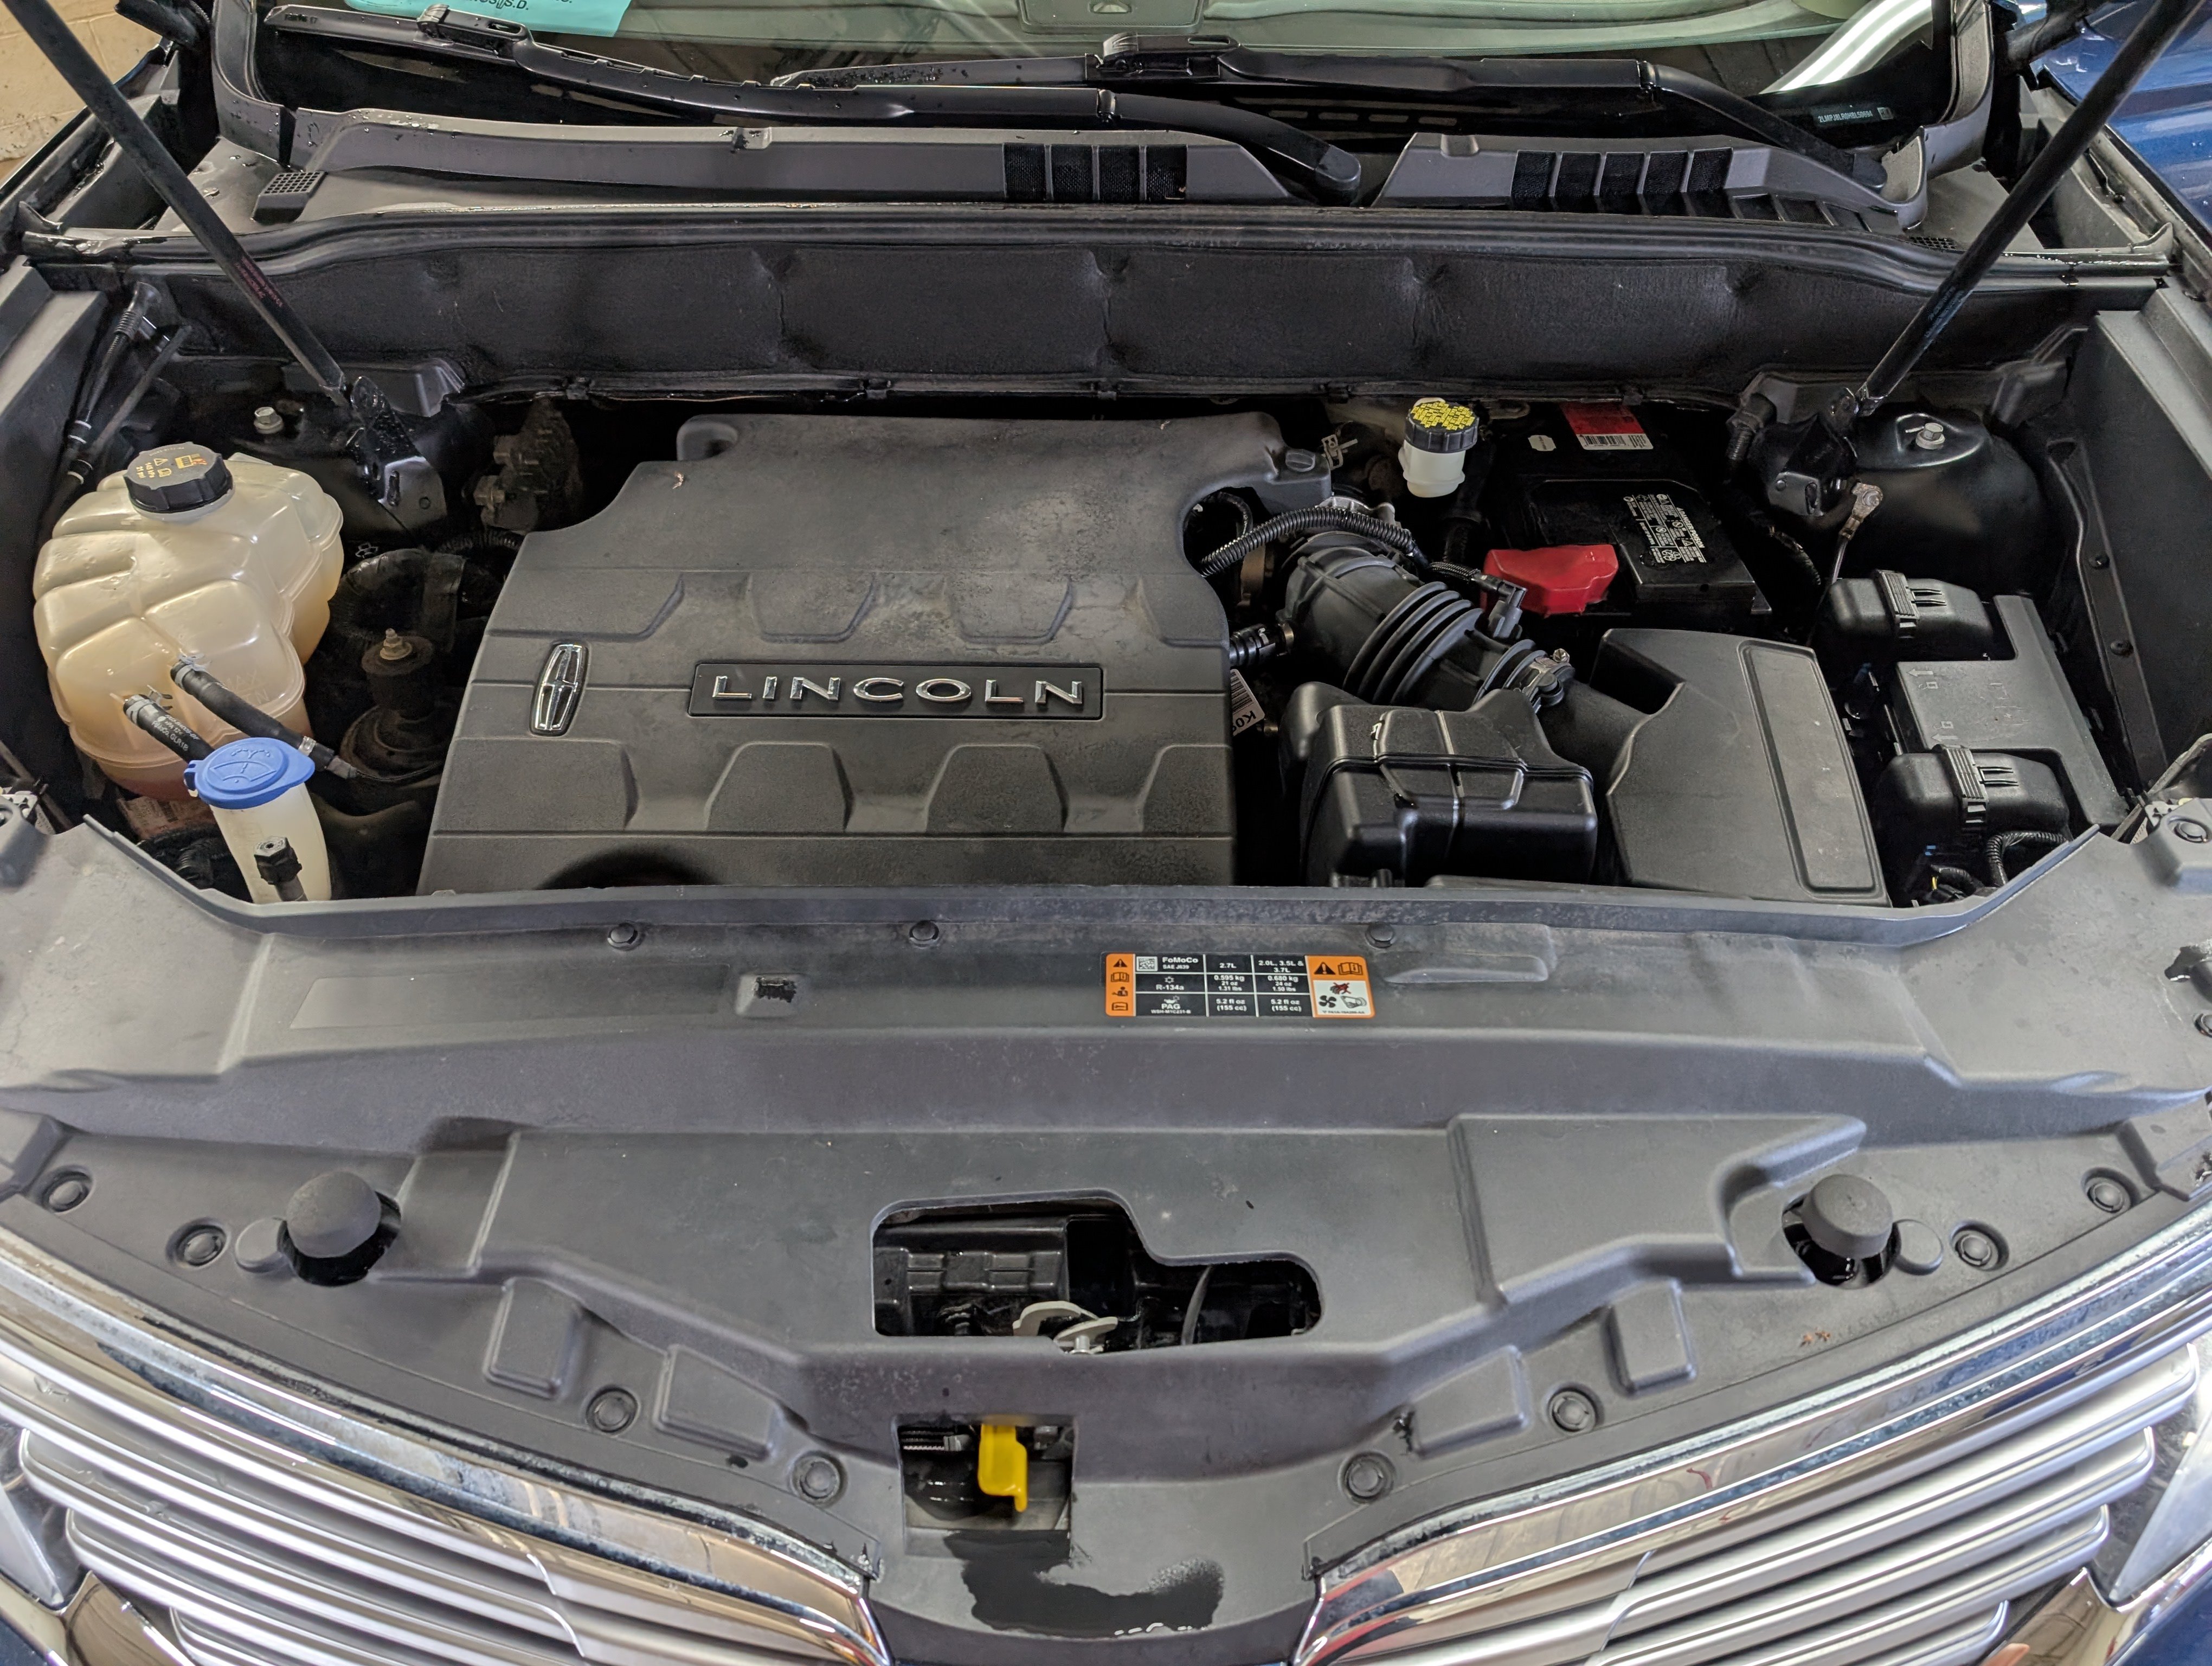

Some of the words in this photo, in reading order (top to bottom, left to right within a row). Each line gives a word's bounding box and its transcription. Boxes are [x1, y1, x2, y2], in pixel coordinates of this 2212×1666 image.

[1679, 511, 1694, 530] DANGER
[1690, 529, 1705, 548] POISON
[712, 676, 1083, 704] LINCOLN
